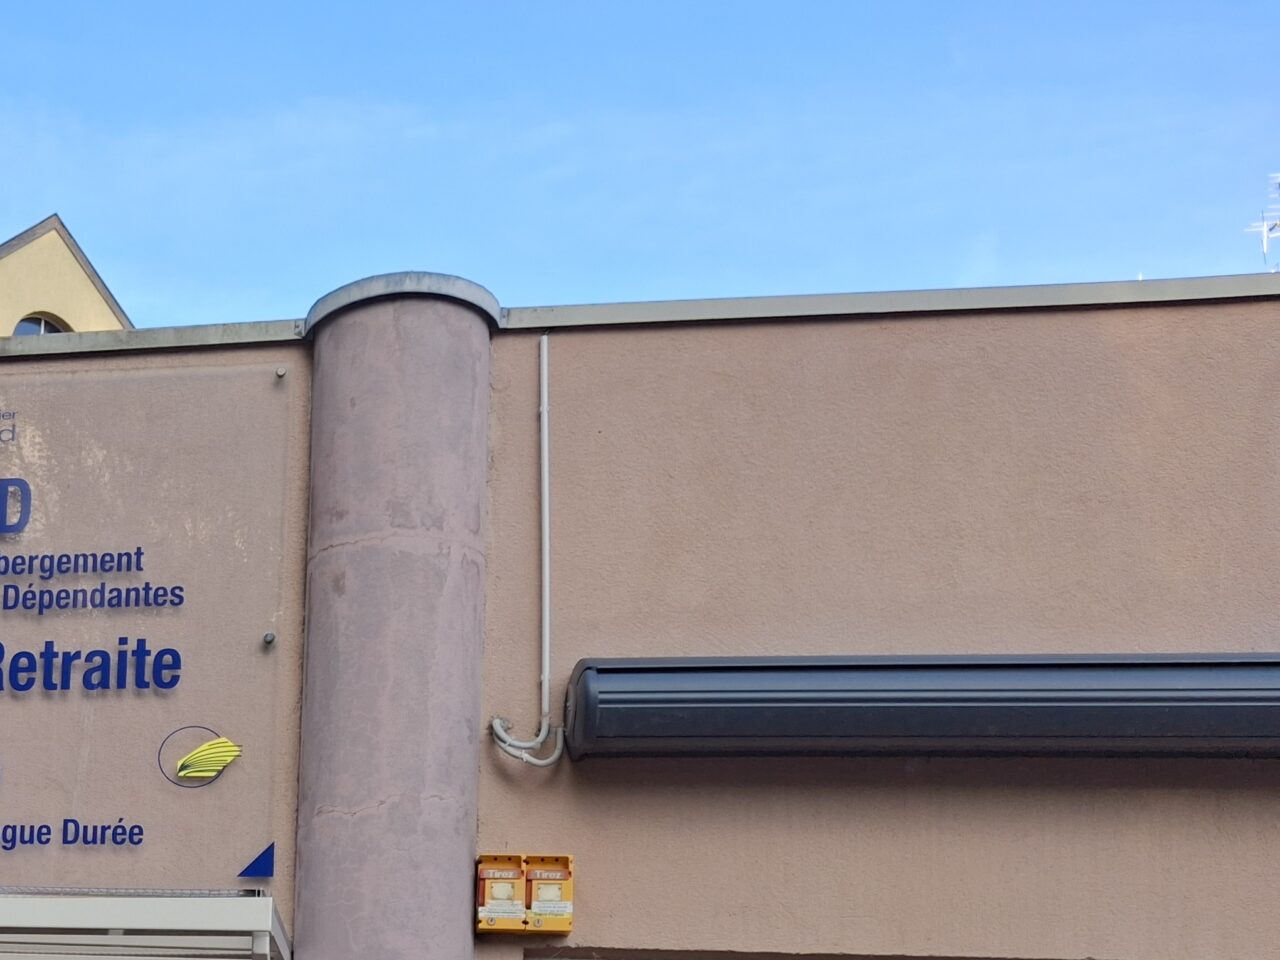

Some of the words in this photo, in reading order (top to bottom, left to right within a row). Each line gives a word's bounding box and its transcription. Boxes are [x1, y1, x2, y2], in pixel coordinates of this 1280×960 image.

[2, 582, 185, 613] Dépendantes
[62, 818, 144, 845] Durée
[487, 869, 514, 878] Tirez
[535, 870, 562, 879] Tirez
